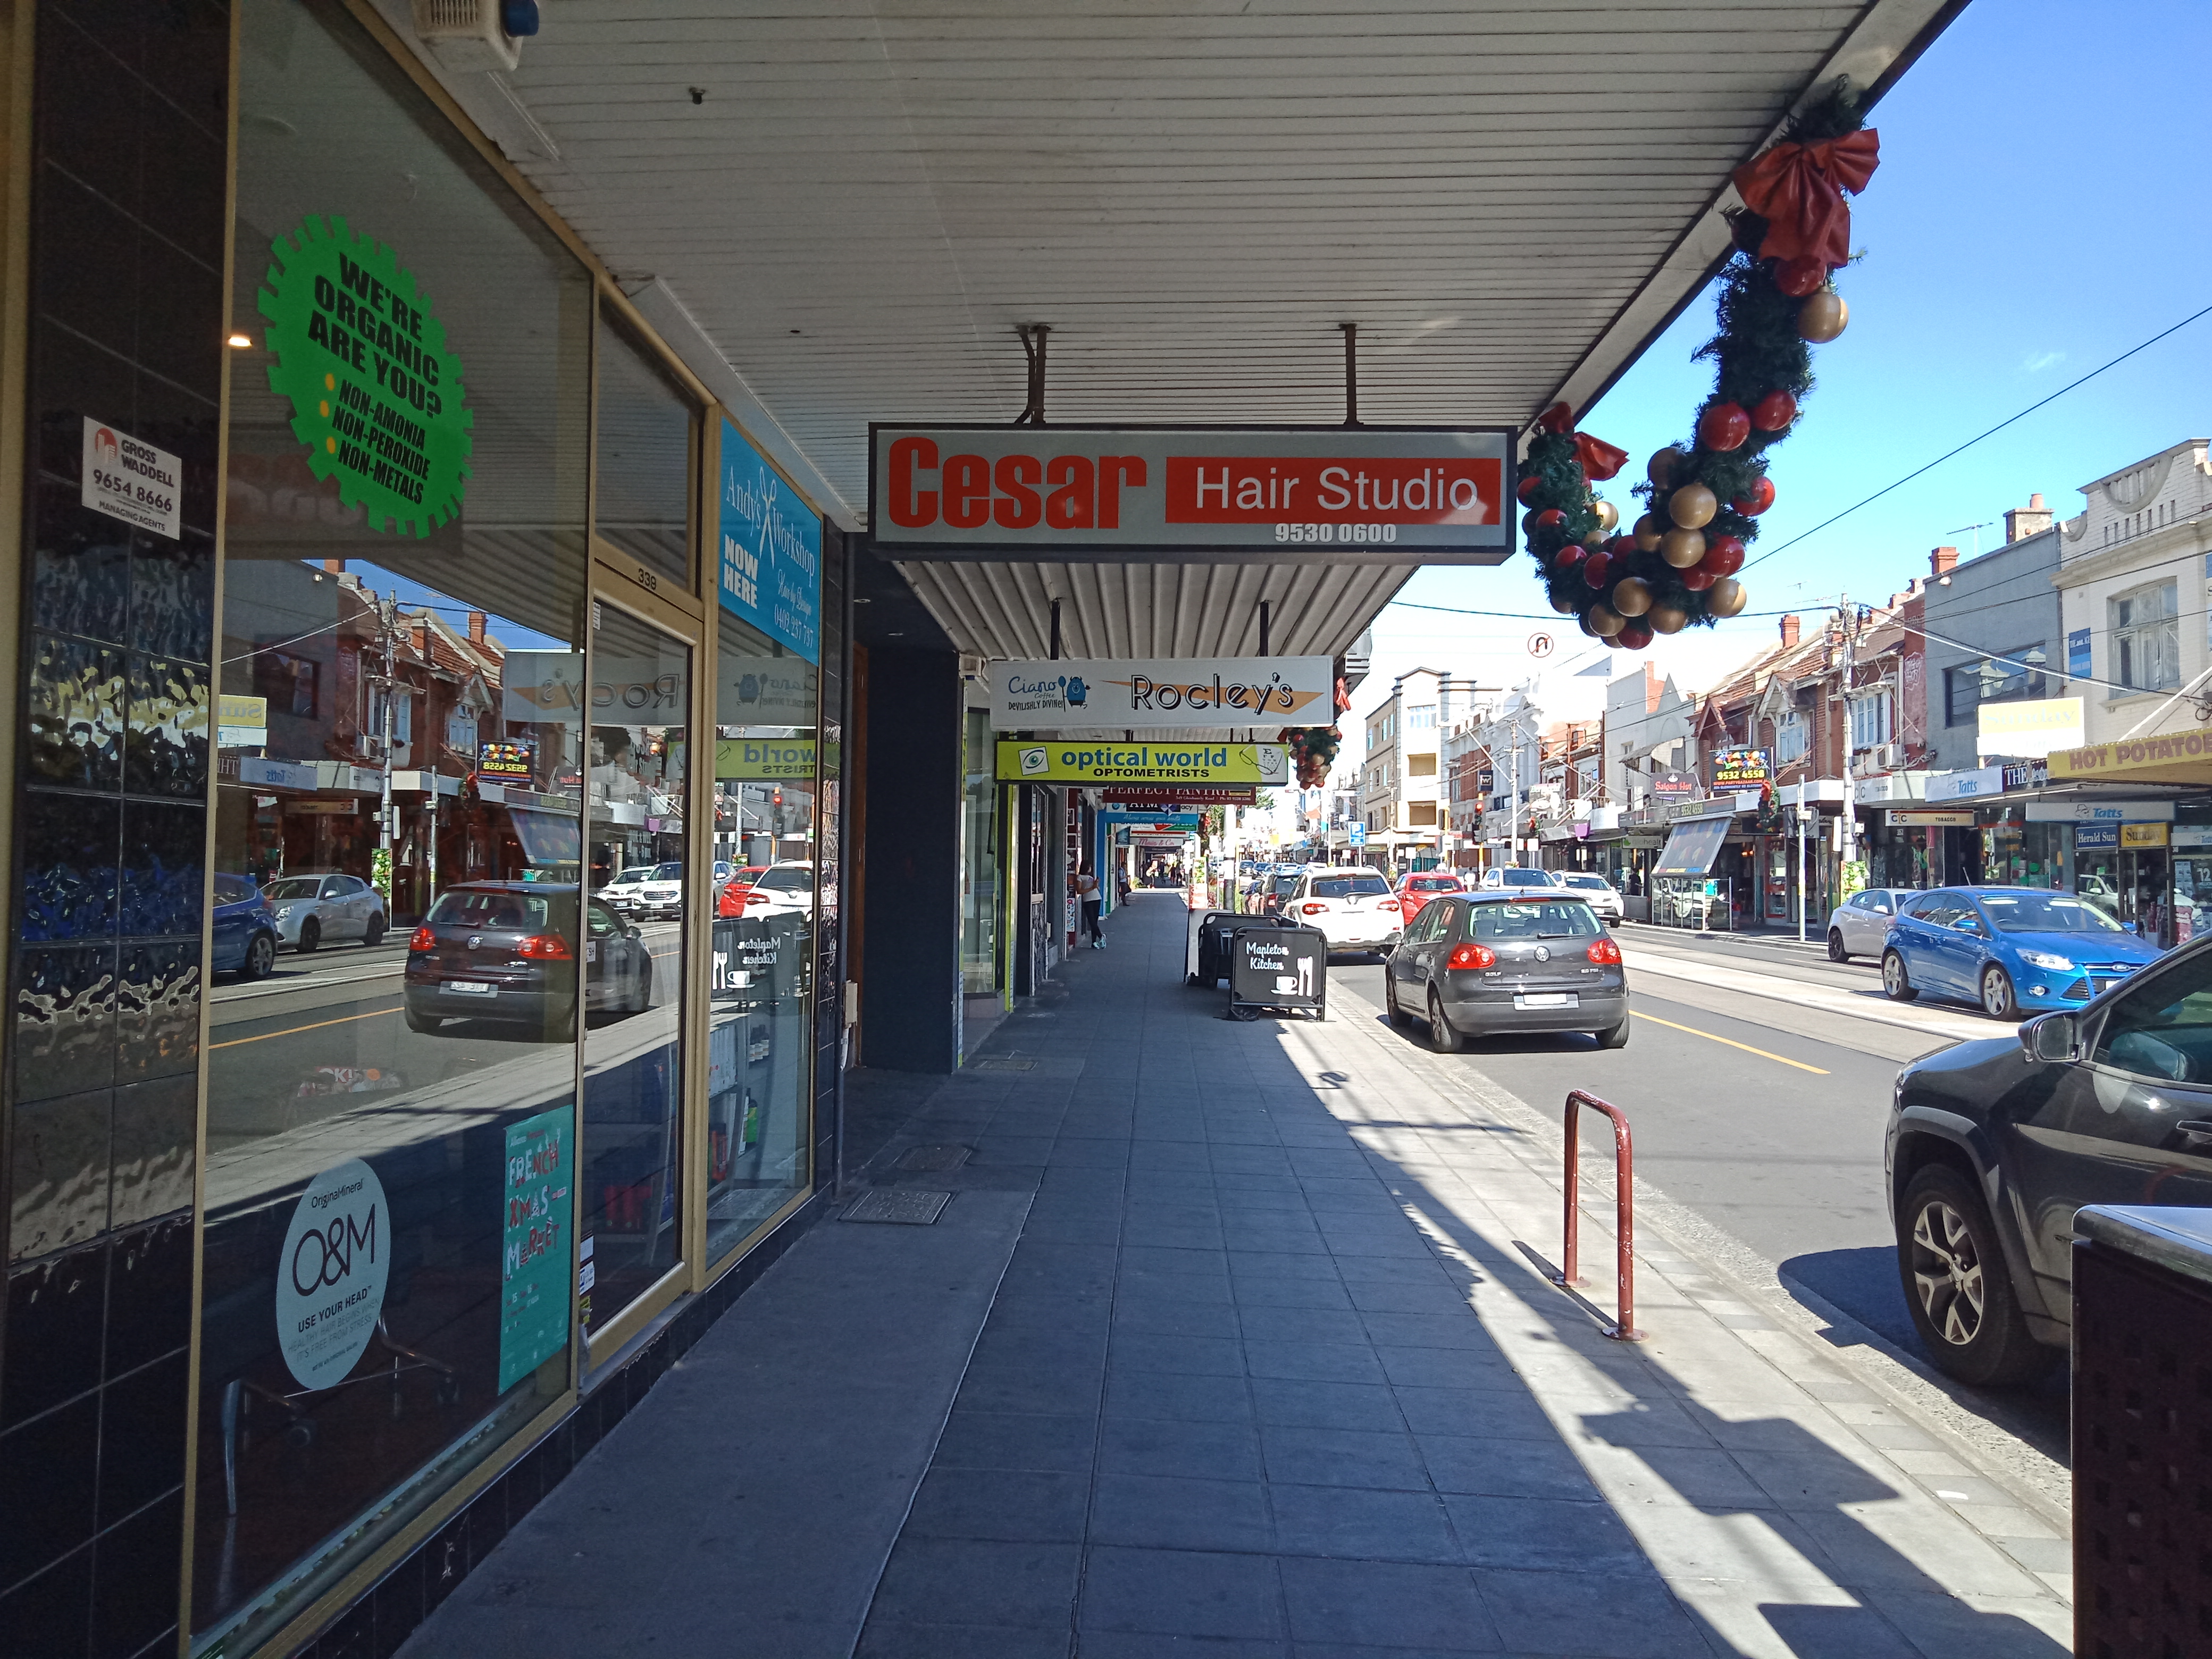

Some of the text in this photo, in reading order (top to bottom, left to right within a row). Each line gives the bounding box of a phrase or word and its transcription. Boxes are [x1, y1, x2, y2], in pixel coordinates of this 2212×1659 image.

[339, 252, 422, 342] WE'RE
[314, 274, 440, 387] ORGANIC
[307, 309, 442, 419] ARE YOU?
[338, 379, 426, 452] NON-AMONIA
[121, 439, 156, 464] GROSS
[332, 405, 431, 481] NON-PEROXIDE
[121, 454, 174, 488] WADDELL
[338, 440, 424, 505] NON-METALS
[887, 436, 1148, 531] Cesar
[93, 468, 131, 496] 9654
[137, 487, 173, 512] 8666
[1196, 466, 1479, 511] Hair Studio
[98, 500, 138, 522] MANAGING
[138, 516, 165, 531] AGENTS
[726, 465, 815, 588] Andy's Workshop
[1274, 522, 1397, 543] 9530 0600
[724, 534, 758, 582] NOW
[638, 568, 657, 590] 339
[724, 563, 758, 610] HERE
[1008, 676, 1058, 694] Ciano
[1130, 672, 1294, 716] Rocley's
[1061, 747, 1227, 771] optical world
[1093, 767, 1210, 777] OPTOMETRISTS
[1716, 769, 1765, 781] 9532 4558
[2004, 766, 2027, 786] THE
[2069, 748, 2108, 770] HOT
[1957, 780, 1978, 794] Tatts
[2093, 808, 2123, 818] Tatts
[2077, 832, 2116, 843] Herald Sun
[2126, 827, 2162, 841] Sunday
[1246, 941, 1289, 958] Mapleton
[1250, 957, 1284, 971] Kitchen
[509, 1139, 560, 1187] FRENCH
[507, 1185, 550, 1233] XMAS
[292, 1203, 376, 1297] O&M
[506, 1217, 560, 1280] MARKET
[298, 1314, 316, 1333] USE
[319, 1301, 343, 1322] YOUR
